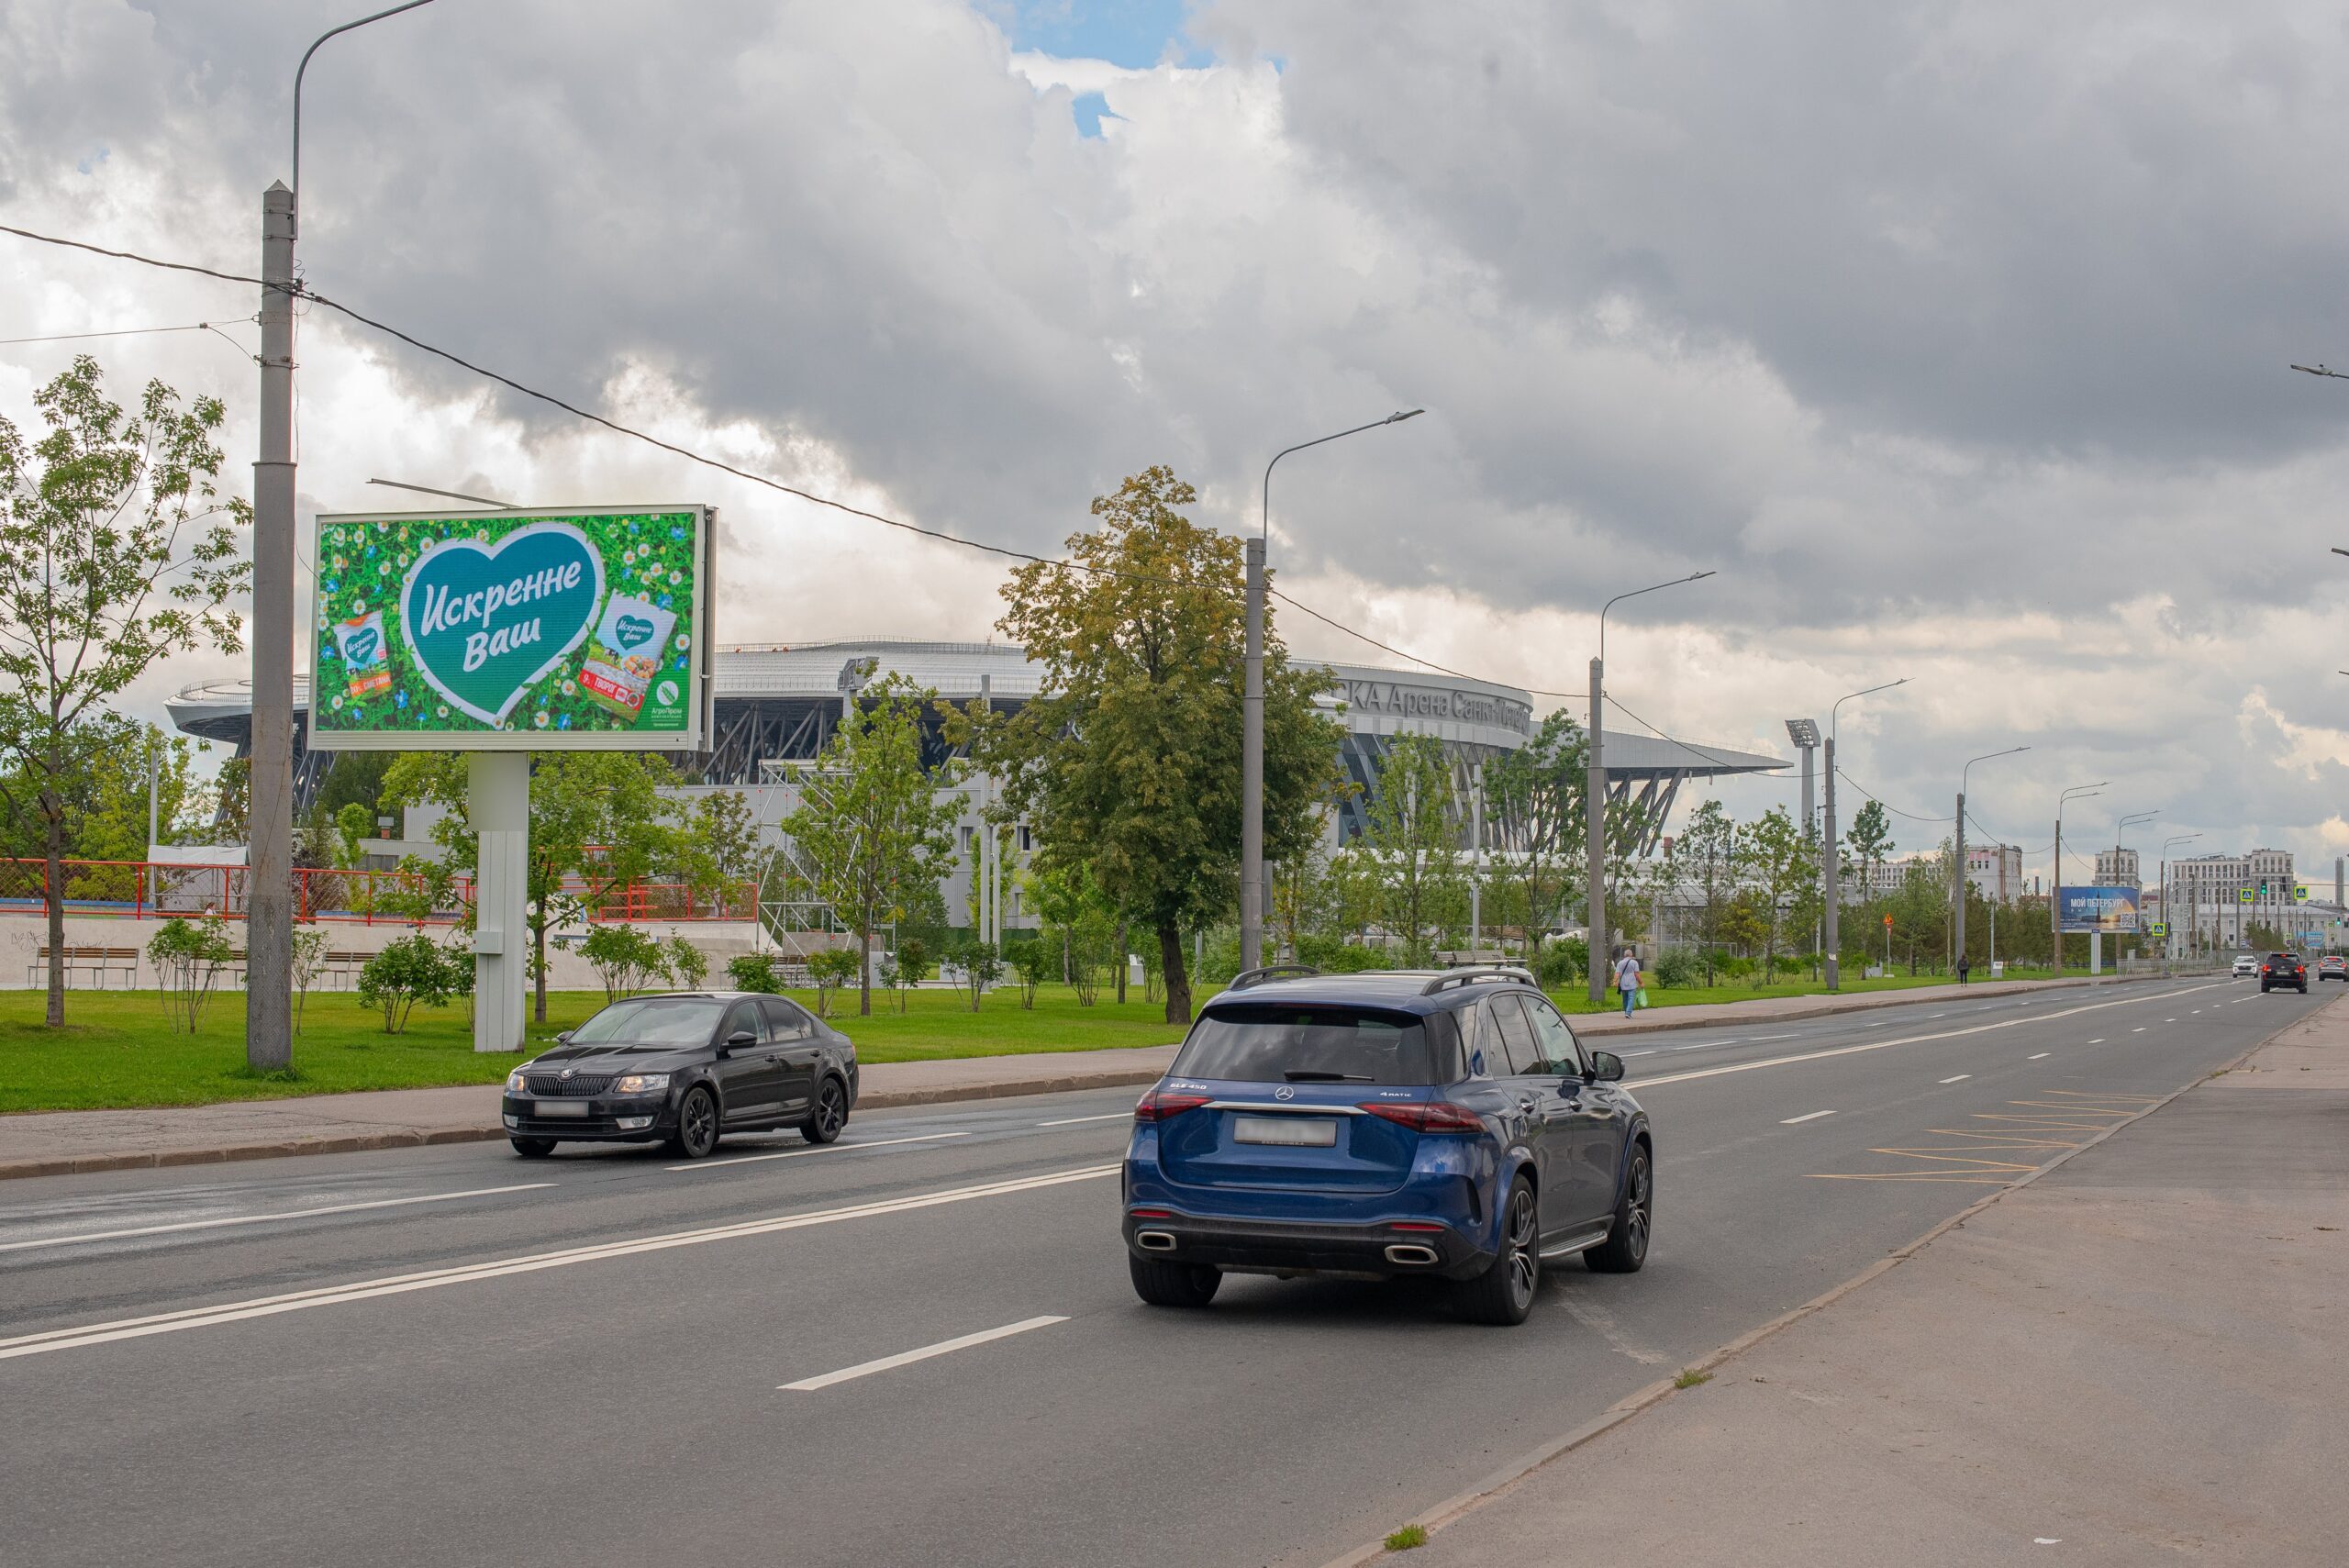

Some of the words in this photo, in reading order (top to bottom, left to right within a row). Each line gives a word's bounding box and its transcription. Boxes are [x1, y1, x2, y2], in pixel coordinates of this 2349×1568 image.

[420, 561, 581, 637] Искренне
[618, 619, 652, 633] Искренне
[623, 631, 641, 640] Ваш
[357, 643, 371, 658] Ваш
[462, 617, 541, 673] Ваш
[594, 677, 617, 694] ТВОРОГ
[1387, 685, 1450, 717] Арена
[2070, 896, 2086, 907] МОЙ
[2087, 898, 2124, 907] ПЕТЕРБУРГ
